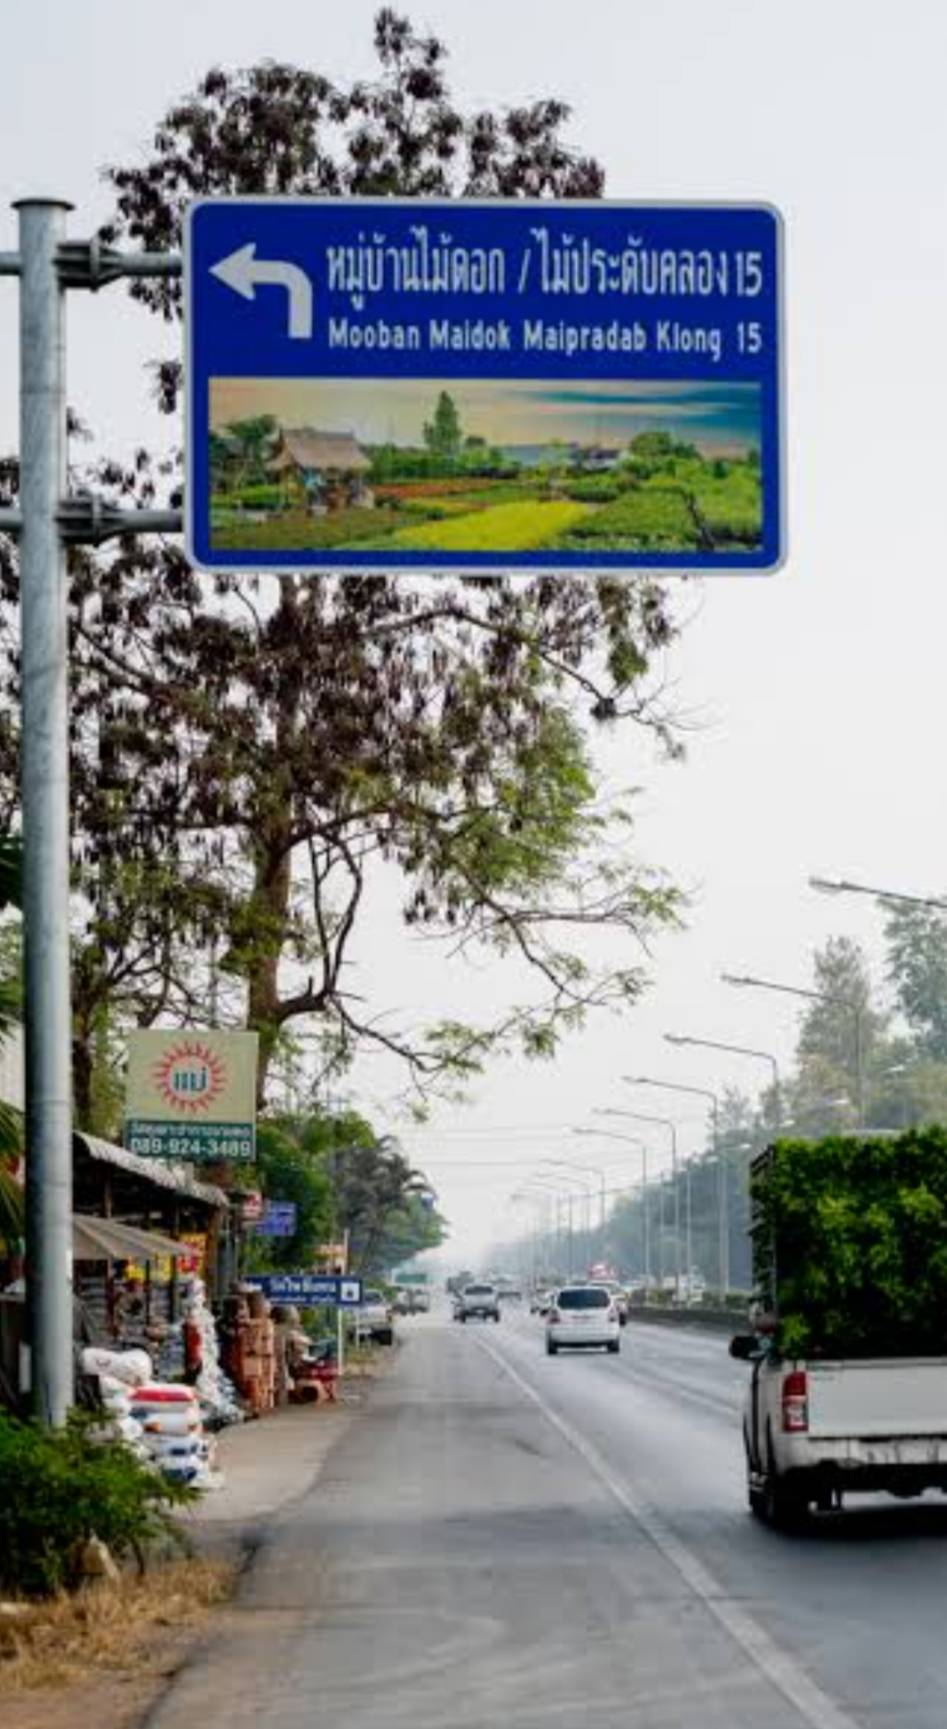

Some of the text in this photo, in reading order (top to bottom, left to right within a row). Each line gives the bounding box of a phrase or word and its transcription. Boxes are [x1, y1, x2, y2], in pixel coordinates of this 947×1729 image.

[327, 225, 505, 311] หมู่บ้านไม้ดอก
[328, 317, 762, 363] Mooban Maidok Maipradab Klong 15
